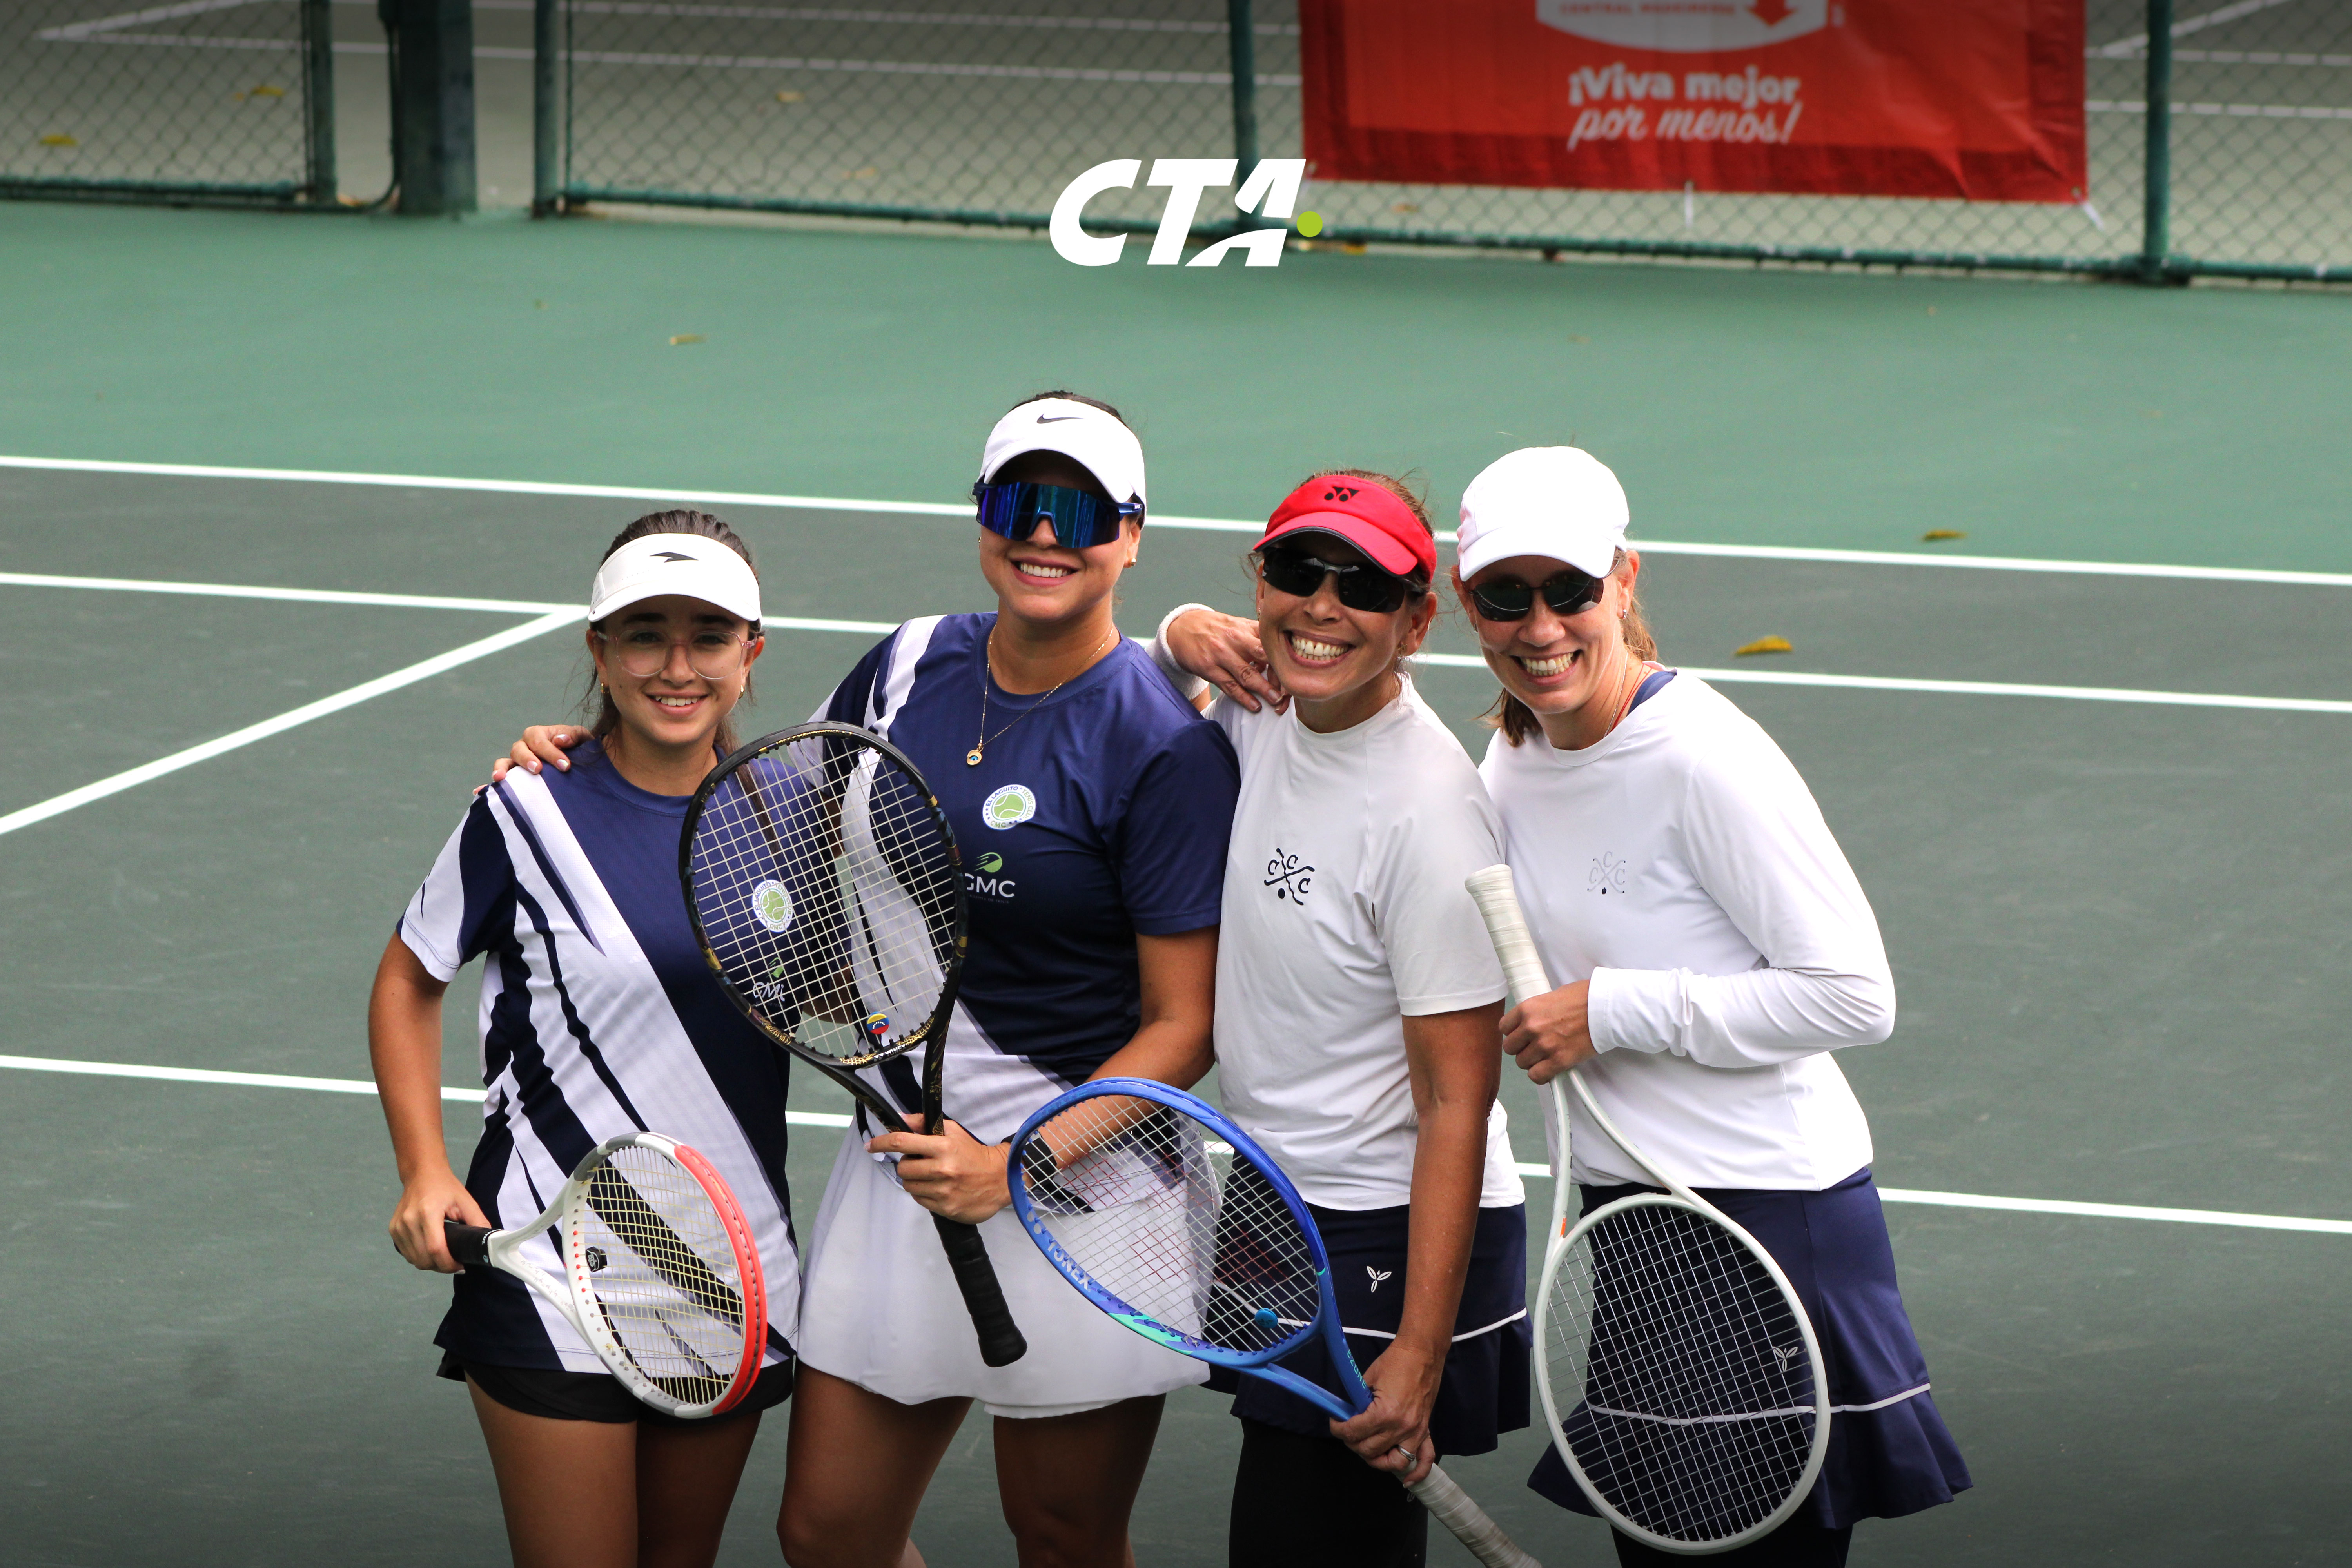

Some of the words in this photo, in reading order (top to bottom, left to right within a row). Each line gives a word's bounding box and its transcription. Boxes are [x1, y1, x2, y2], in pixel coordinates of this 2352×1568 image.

[1568, 62, 1675, 106] ¡Viva
[1684, 64, 1802, 109] mejor
[1567, 105, 1648, 152] por
[1656, 101, 1803, 144] menos!
[991, 786, 1018, 799] LAGUITO
[1022, 789, 1034, 805] TENIS
[884, 1043, 906, 1056] YONEX
